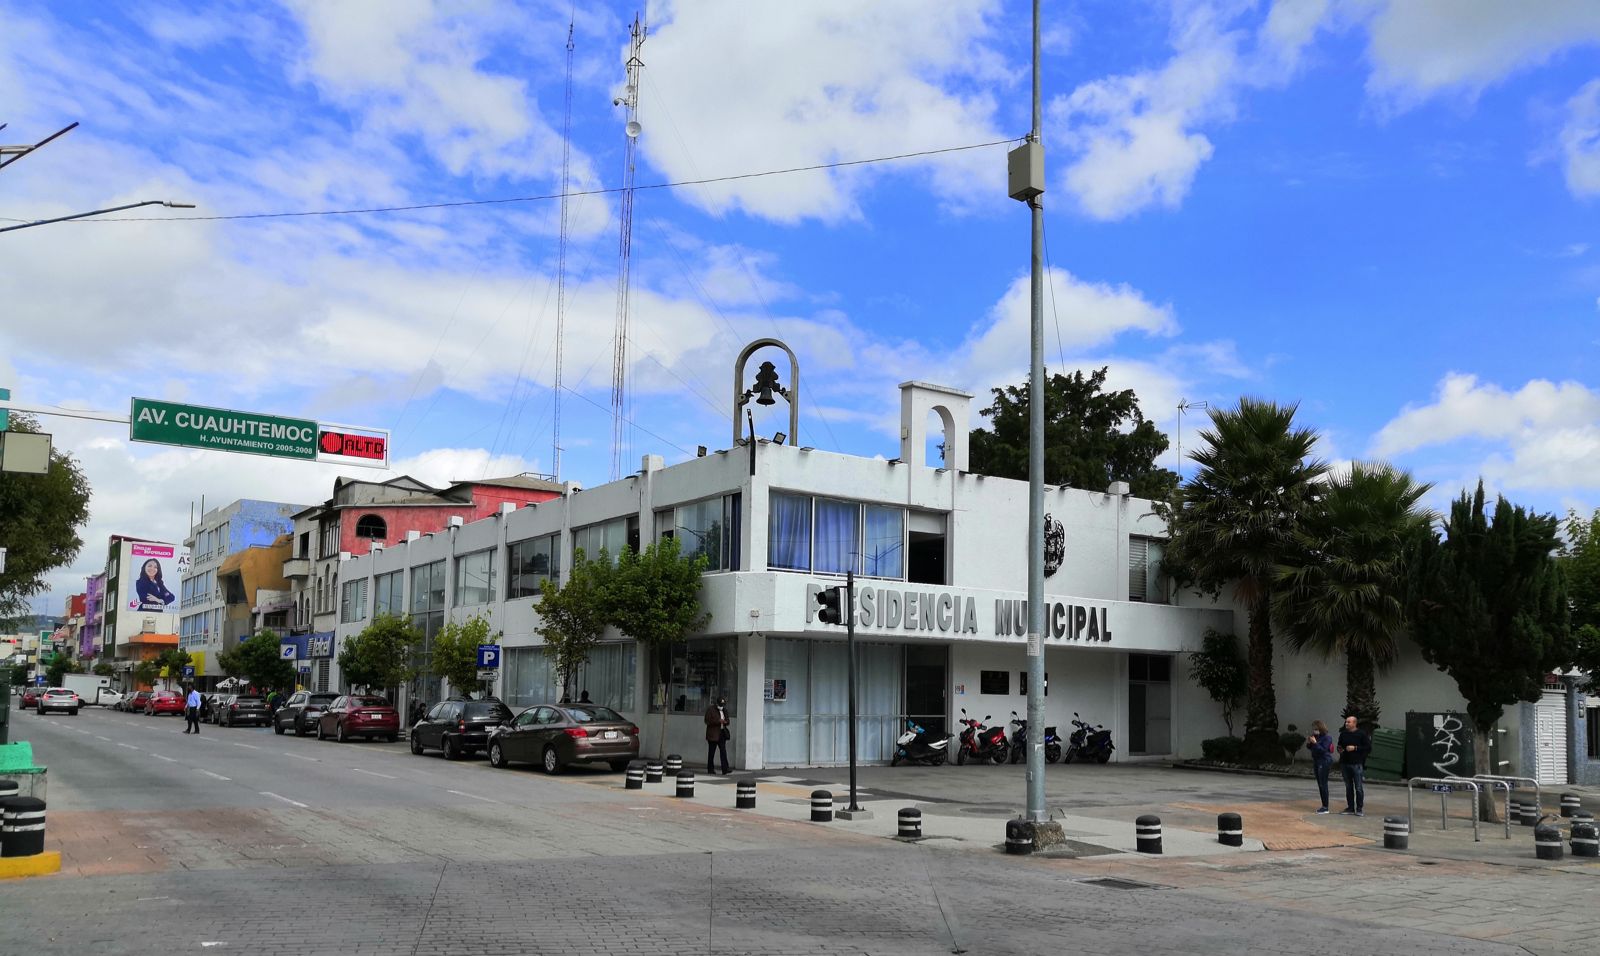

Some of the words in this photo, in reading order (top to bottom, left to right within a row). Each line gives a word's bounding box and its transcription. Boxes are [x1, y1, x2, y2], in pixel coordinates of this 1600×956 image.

[138, 407, 169, 426] AV.
[175, 412, 313, 442] CUAUHTEMOC
[200, 434, 209, 443] H.
[210, 435, 274, 449] AYUNTAMIENTO
[275, 444, 313, 454] 2005-2008
[345, 439, 385, 454] ALTO
[806, 583, 978, 633] PESIDENCIA
[484, 651, 495, 665] P
